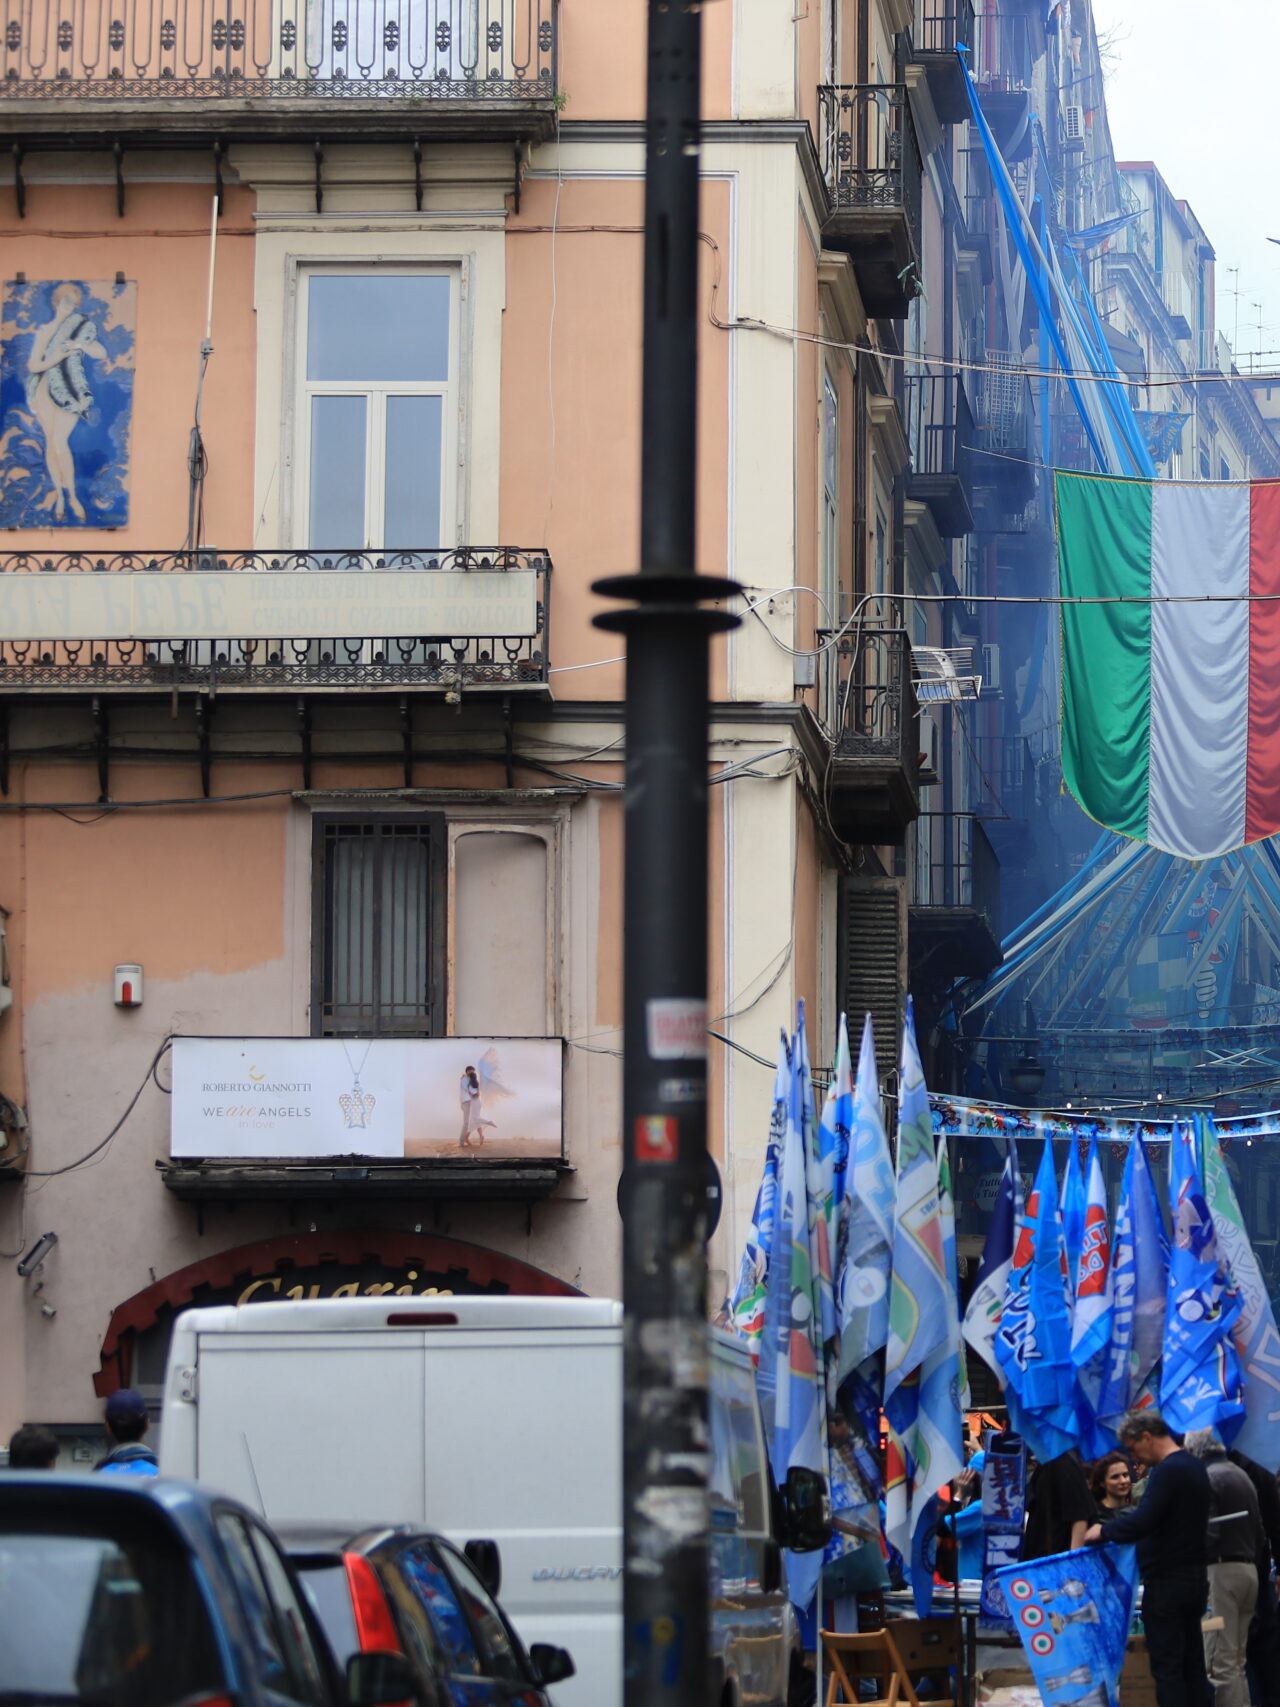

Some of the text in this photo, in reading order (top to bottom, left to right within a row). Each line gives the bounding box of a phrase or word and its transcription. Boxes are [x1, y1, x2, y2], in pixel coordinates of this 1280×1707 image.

[202, 1082, 312, 1092] ROBERTO GIANNOTTI
[202, 1105, 312, 1118] WE are ANGELS
[239, 1120, 276, 1129] in love
[532, 1566, 623, 1581] DUCAT
